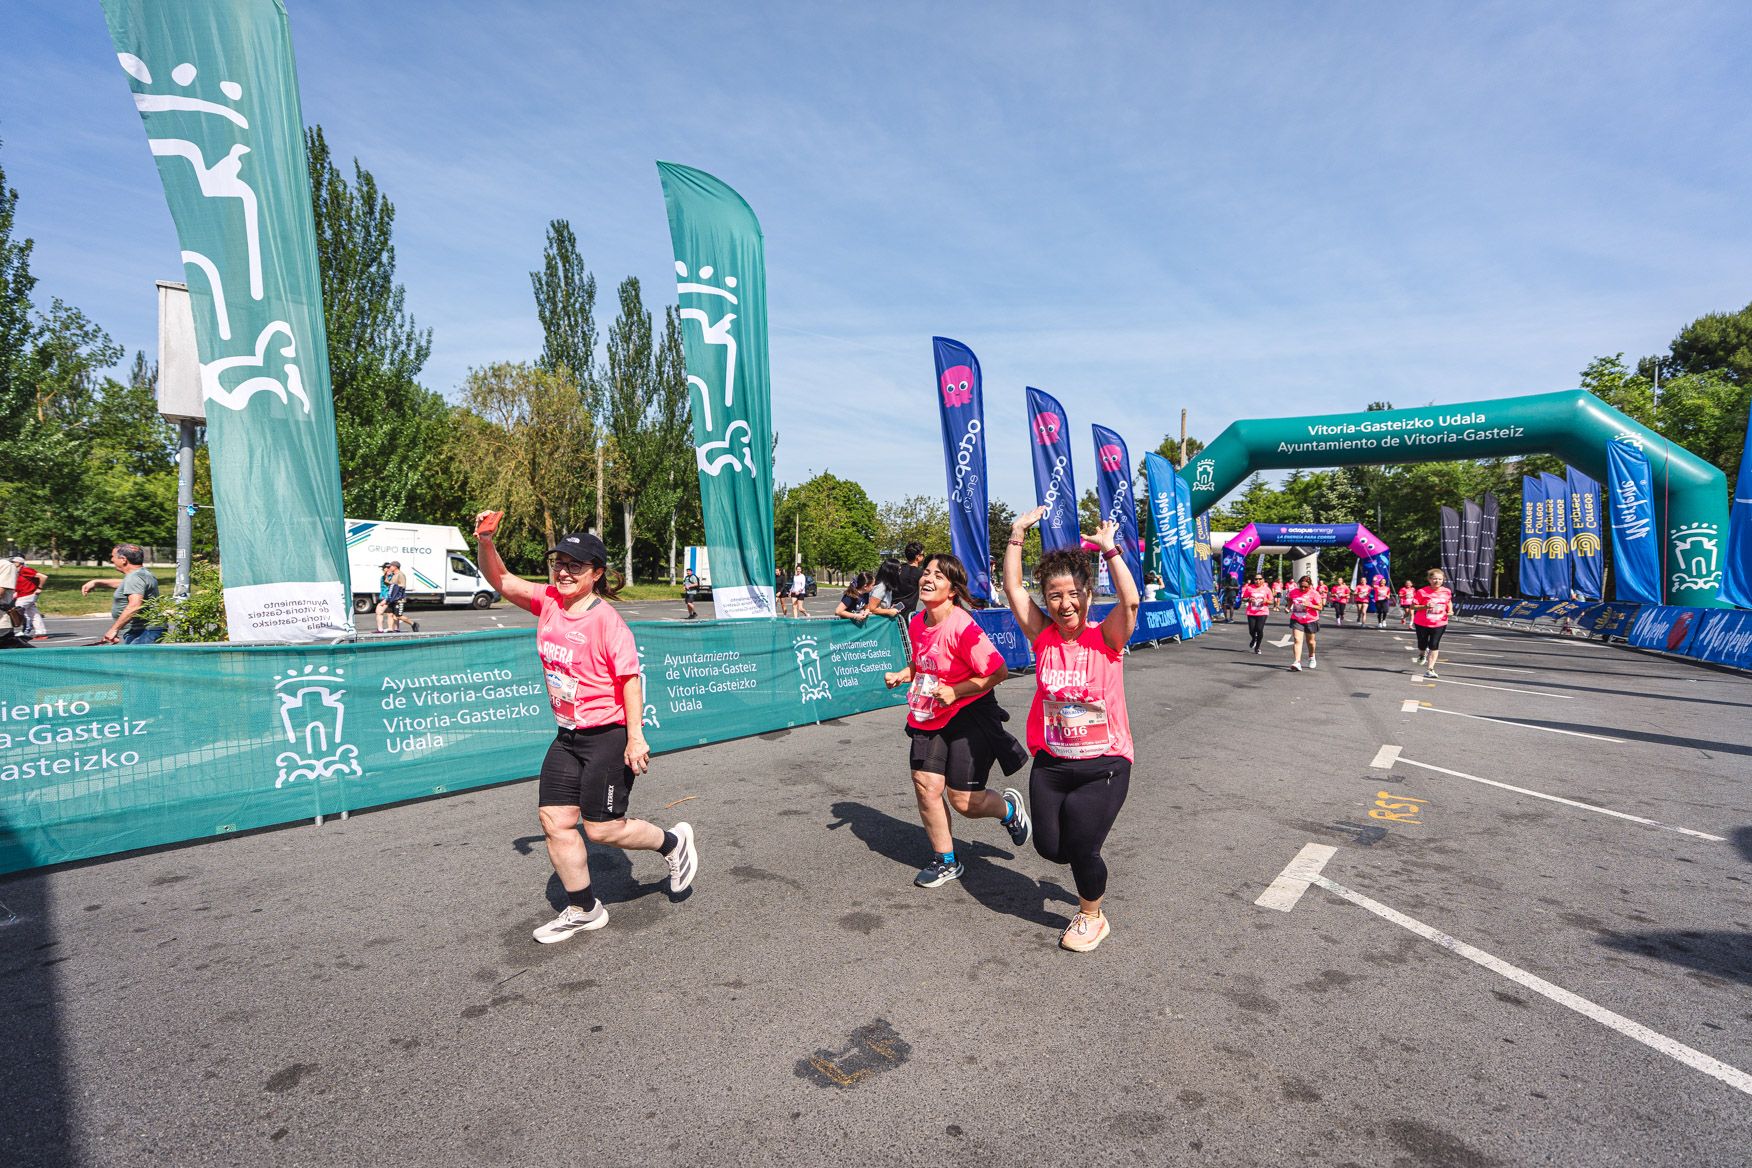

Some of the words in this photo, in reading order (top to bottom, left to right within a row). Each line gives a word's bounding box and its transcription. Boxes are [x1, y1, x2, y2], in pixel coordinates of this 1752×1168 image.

[1308, 417, 1434, 436] Vitoria-Gasteizko
[1439, 412, 1486, 427] Udala
[1278, 438, 1377, 454] Ayuntamiento
[1381, 434, 1400, 447] de
[1404, 425, 1524, 446] Vitoria-Gasteiz
[368, 545, 398, 553] GRUPO
[402, 546, 432, 554] ELEYCO
[829, 639, 878, 653] Ayuntamiento
[831, 653, 841, 663] de
[841, 648, 892, 661] Vitoria-Gasteiz
[664, 650, 740, 668] Ayuntamiento
[665, 668, 680, 680] de
[683, 661, 757, 678] Vitoria-Gasteiz
[834, 662, 893, 676] Vitoria-Gasteizko
[381, 668, 512, 694] Ayuntamiento
[667, 677, 757, 698] Vitoria-Gasteizko
[836, 677, 859, 688] Udala
[381, 693, 407, 710] de
[412, 681, 542, 707] Vitoria-Gasteiz
[670, 698, 703, 713] Udala
[383, 703, 540, 734] Vitoria-Gasteizko
[386, 733, 444, 754] Udala
